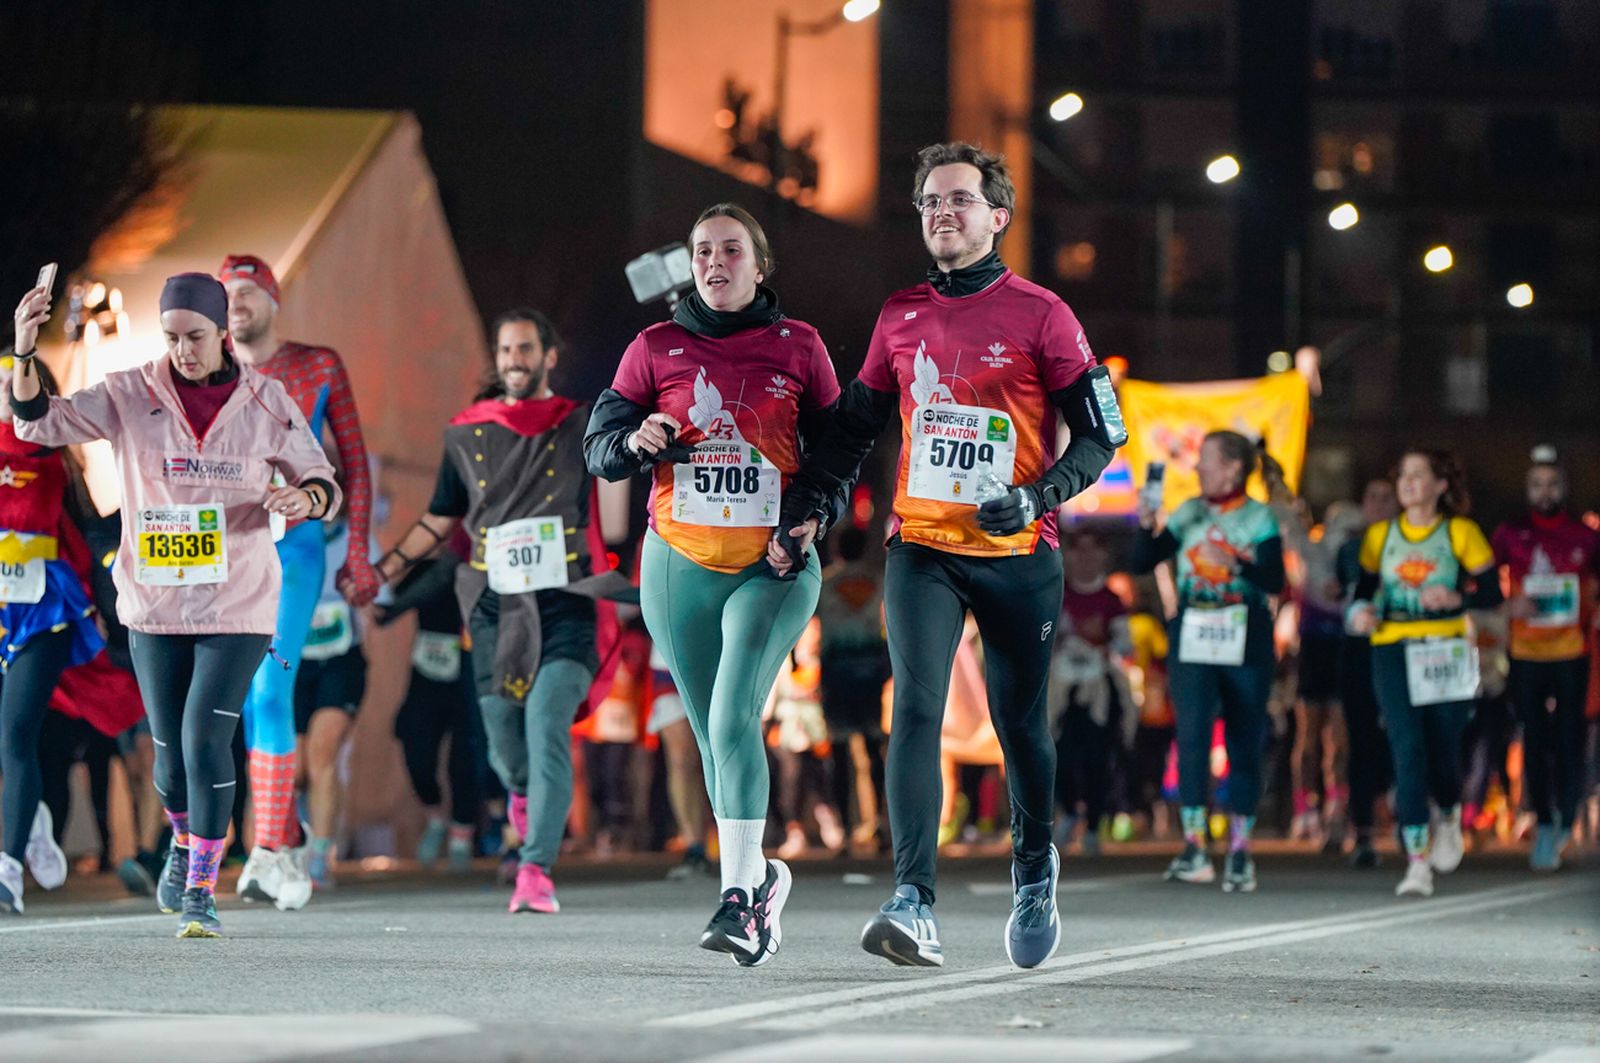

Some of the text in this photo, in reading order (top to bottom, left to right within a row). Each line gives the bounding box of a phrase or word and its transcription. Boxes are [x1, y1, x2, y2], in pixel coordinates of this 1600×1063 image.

[936, 414, 964, 427] NOCHE
[966, 417, 980, 427] DE
[708, 417, 734, 440] 43
[924, 425, 943, 436] SAN
[945, 427, 978, 440] ANTÓN
[729, 445, 741, 453] DE
[690, 454, 705, 464] AN
[186, 458, 242, 476] NORWAY
[162, 472, 243, 482] EXPEDITION
[694, 466, 759, 494] 5708
[726, 496, 747, 504] Teresa
[155, 513, 179, 522] NOCHE
[180, 513, 191, 522] DE
[145, 524, 162, 532] SAN
[145, 533, 216, 558] 13536
[507, 545, 542, 567] 307
